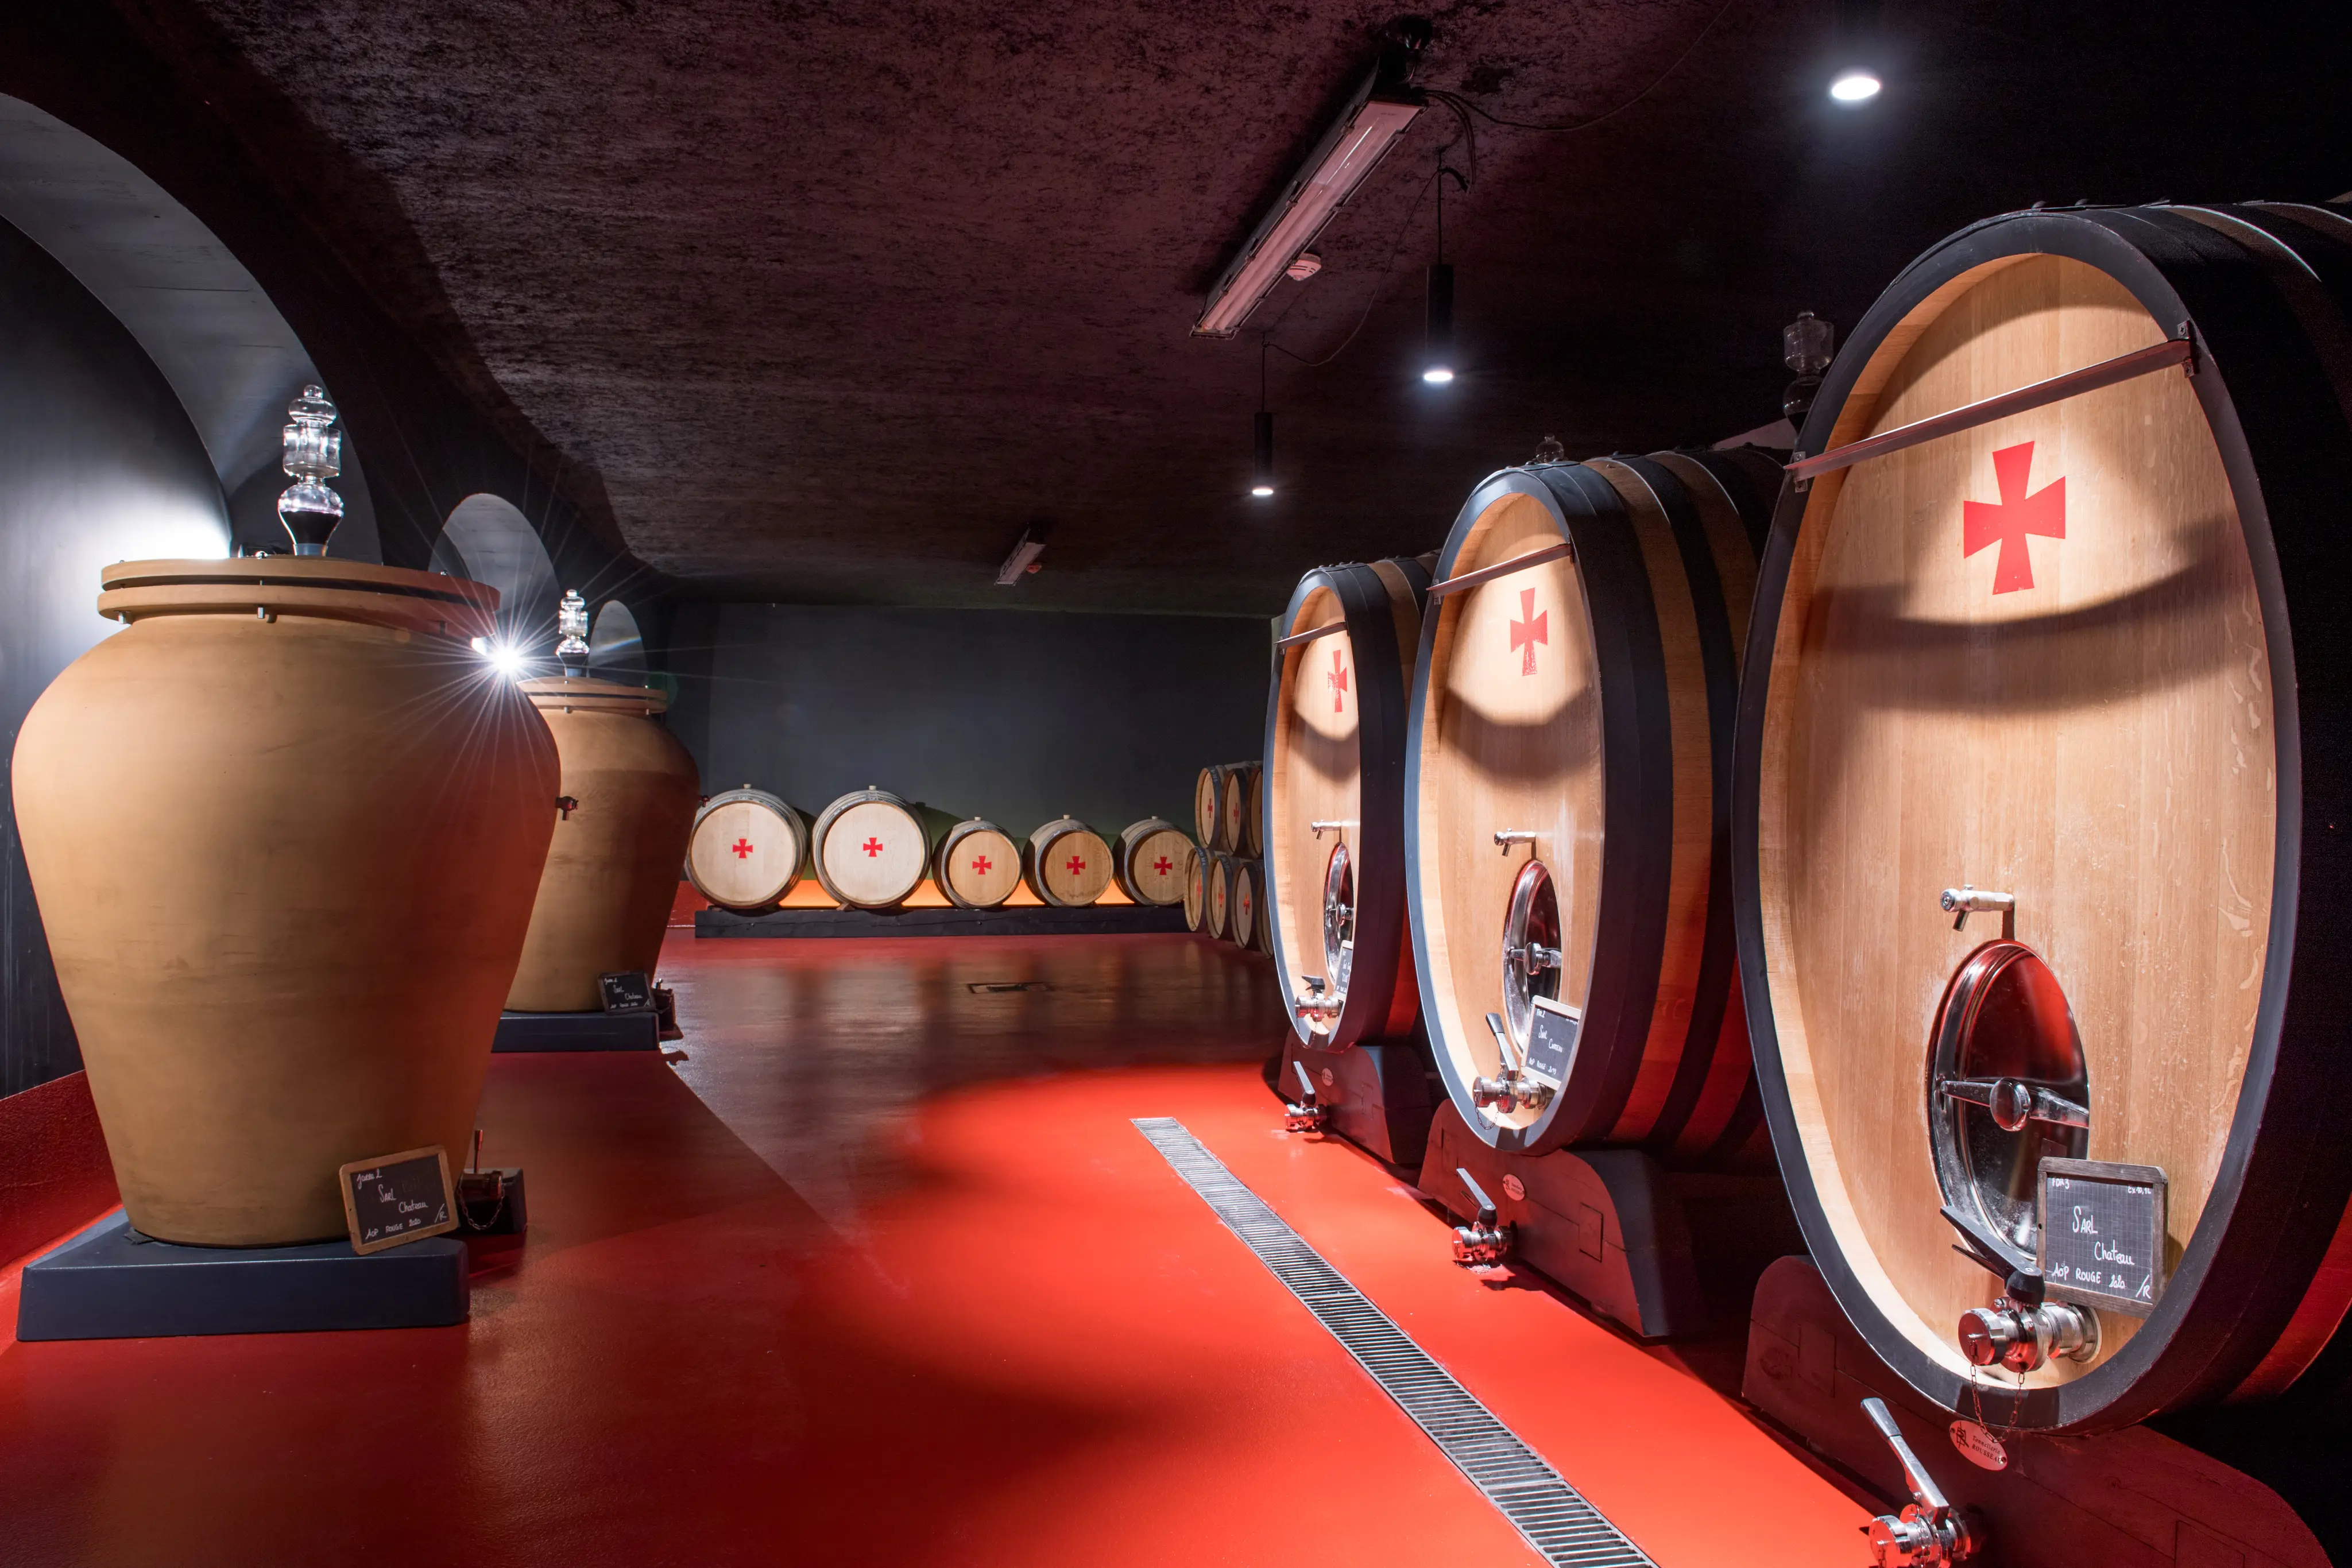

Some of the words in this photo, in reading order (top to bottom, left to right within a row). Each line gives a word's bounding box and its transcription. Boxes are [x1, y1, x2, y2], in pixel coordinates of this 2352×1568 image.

[2095, 1240, 2134, 1265] Chateau
[2076, 1267, 2102, 1284] ROUGE
[1972, 1435, 2001, 1454] Tonnellerie
